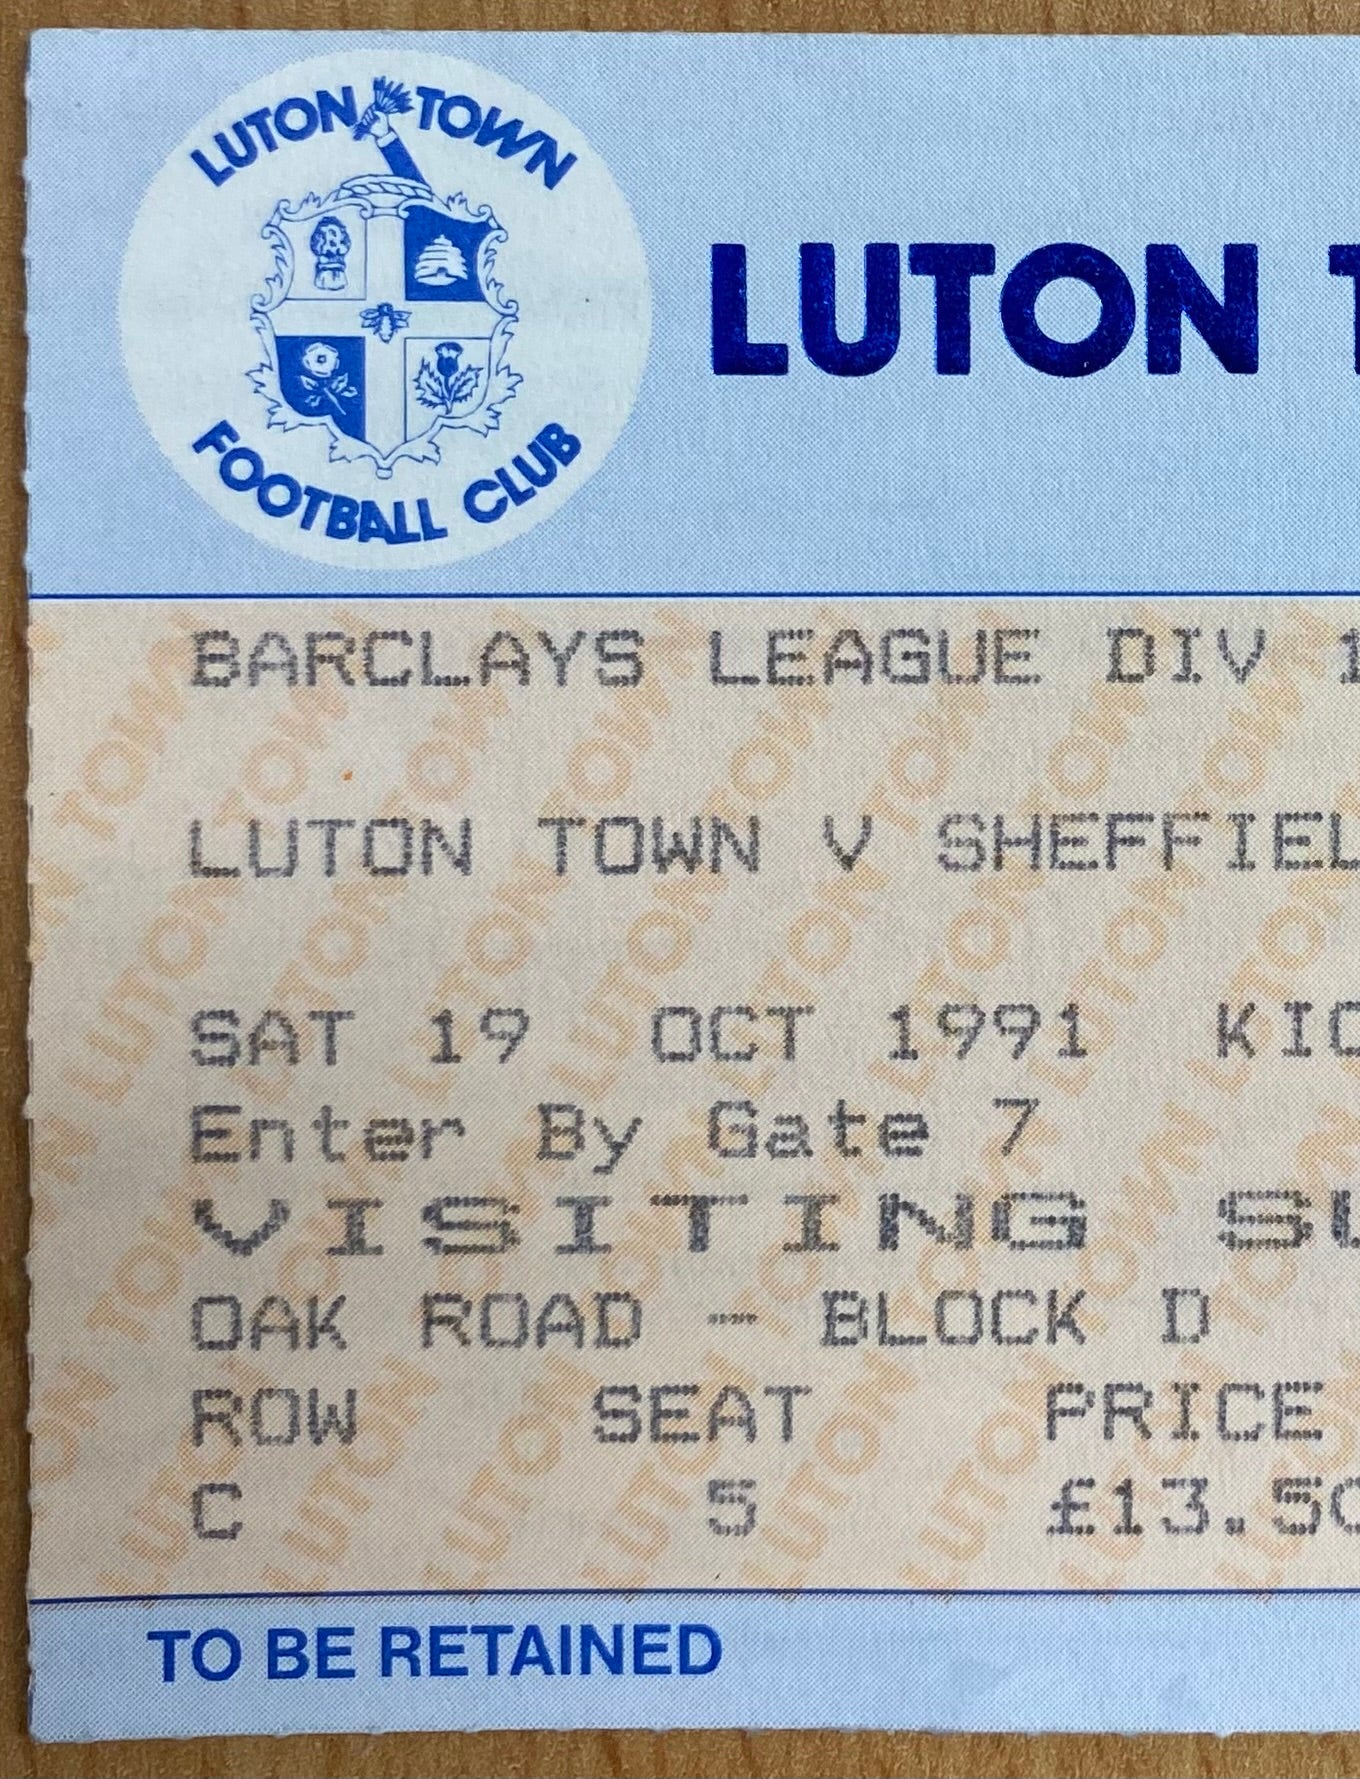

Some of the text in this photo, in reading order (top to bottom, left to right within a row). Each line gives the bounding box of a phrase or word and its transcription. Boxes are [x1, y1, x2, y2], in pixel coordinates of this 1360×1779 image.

[190, 85, 578, 190] LUTON TOWN
[711, 241, 1259, 377] LUTON
[192, 419, 582, 545] FOOTBALL CLUB
[190, 629, 645, 688] BARCLAYS
[709, 628, 1041, 687] LEAGUE
[1106, 627, 1266, 684] DIV
[188, 817, 472, 879] LUTON
[537, 815, 760, 877] TOWN
[823, 815, 872, 872] V
[190, 1009, 354, 1068] SAT
[430, 1007, 530, 1064] 19
[651, 1005, 814, 1063] OCT
[889, 1002, 1088, 1061] 1991
[189, 1097, 1040, 1176] Enter By Gate 7
[193, 1193, 1087, 1257] VISITING
[191, 1287, 1210, 1351] OAK ROAD - BLOCK D
[191, 1380, 1324, 1447] ROW SEAT PRICE
[191, 1482, 243, 1540] C
[707, 1479, 757, 1537] 5
[146, 1623, 723, 1683] TO BE RETAINED
